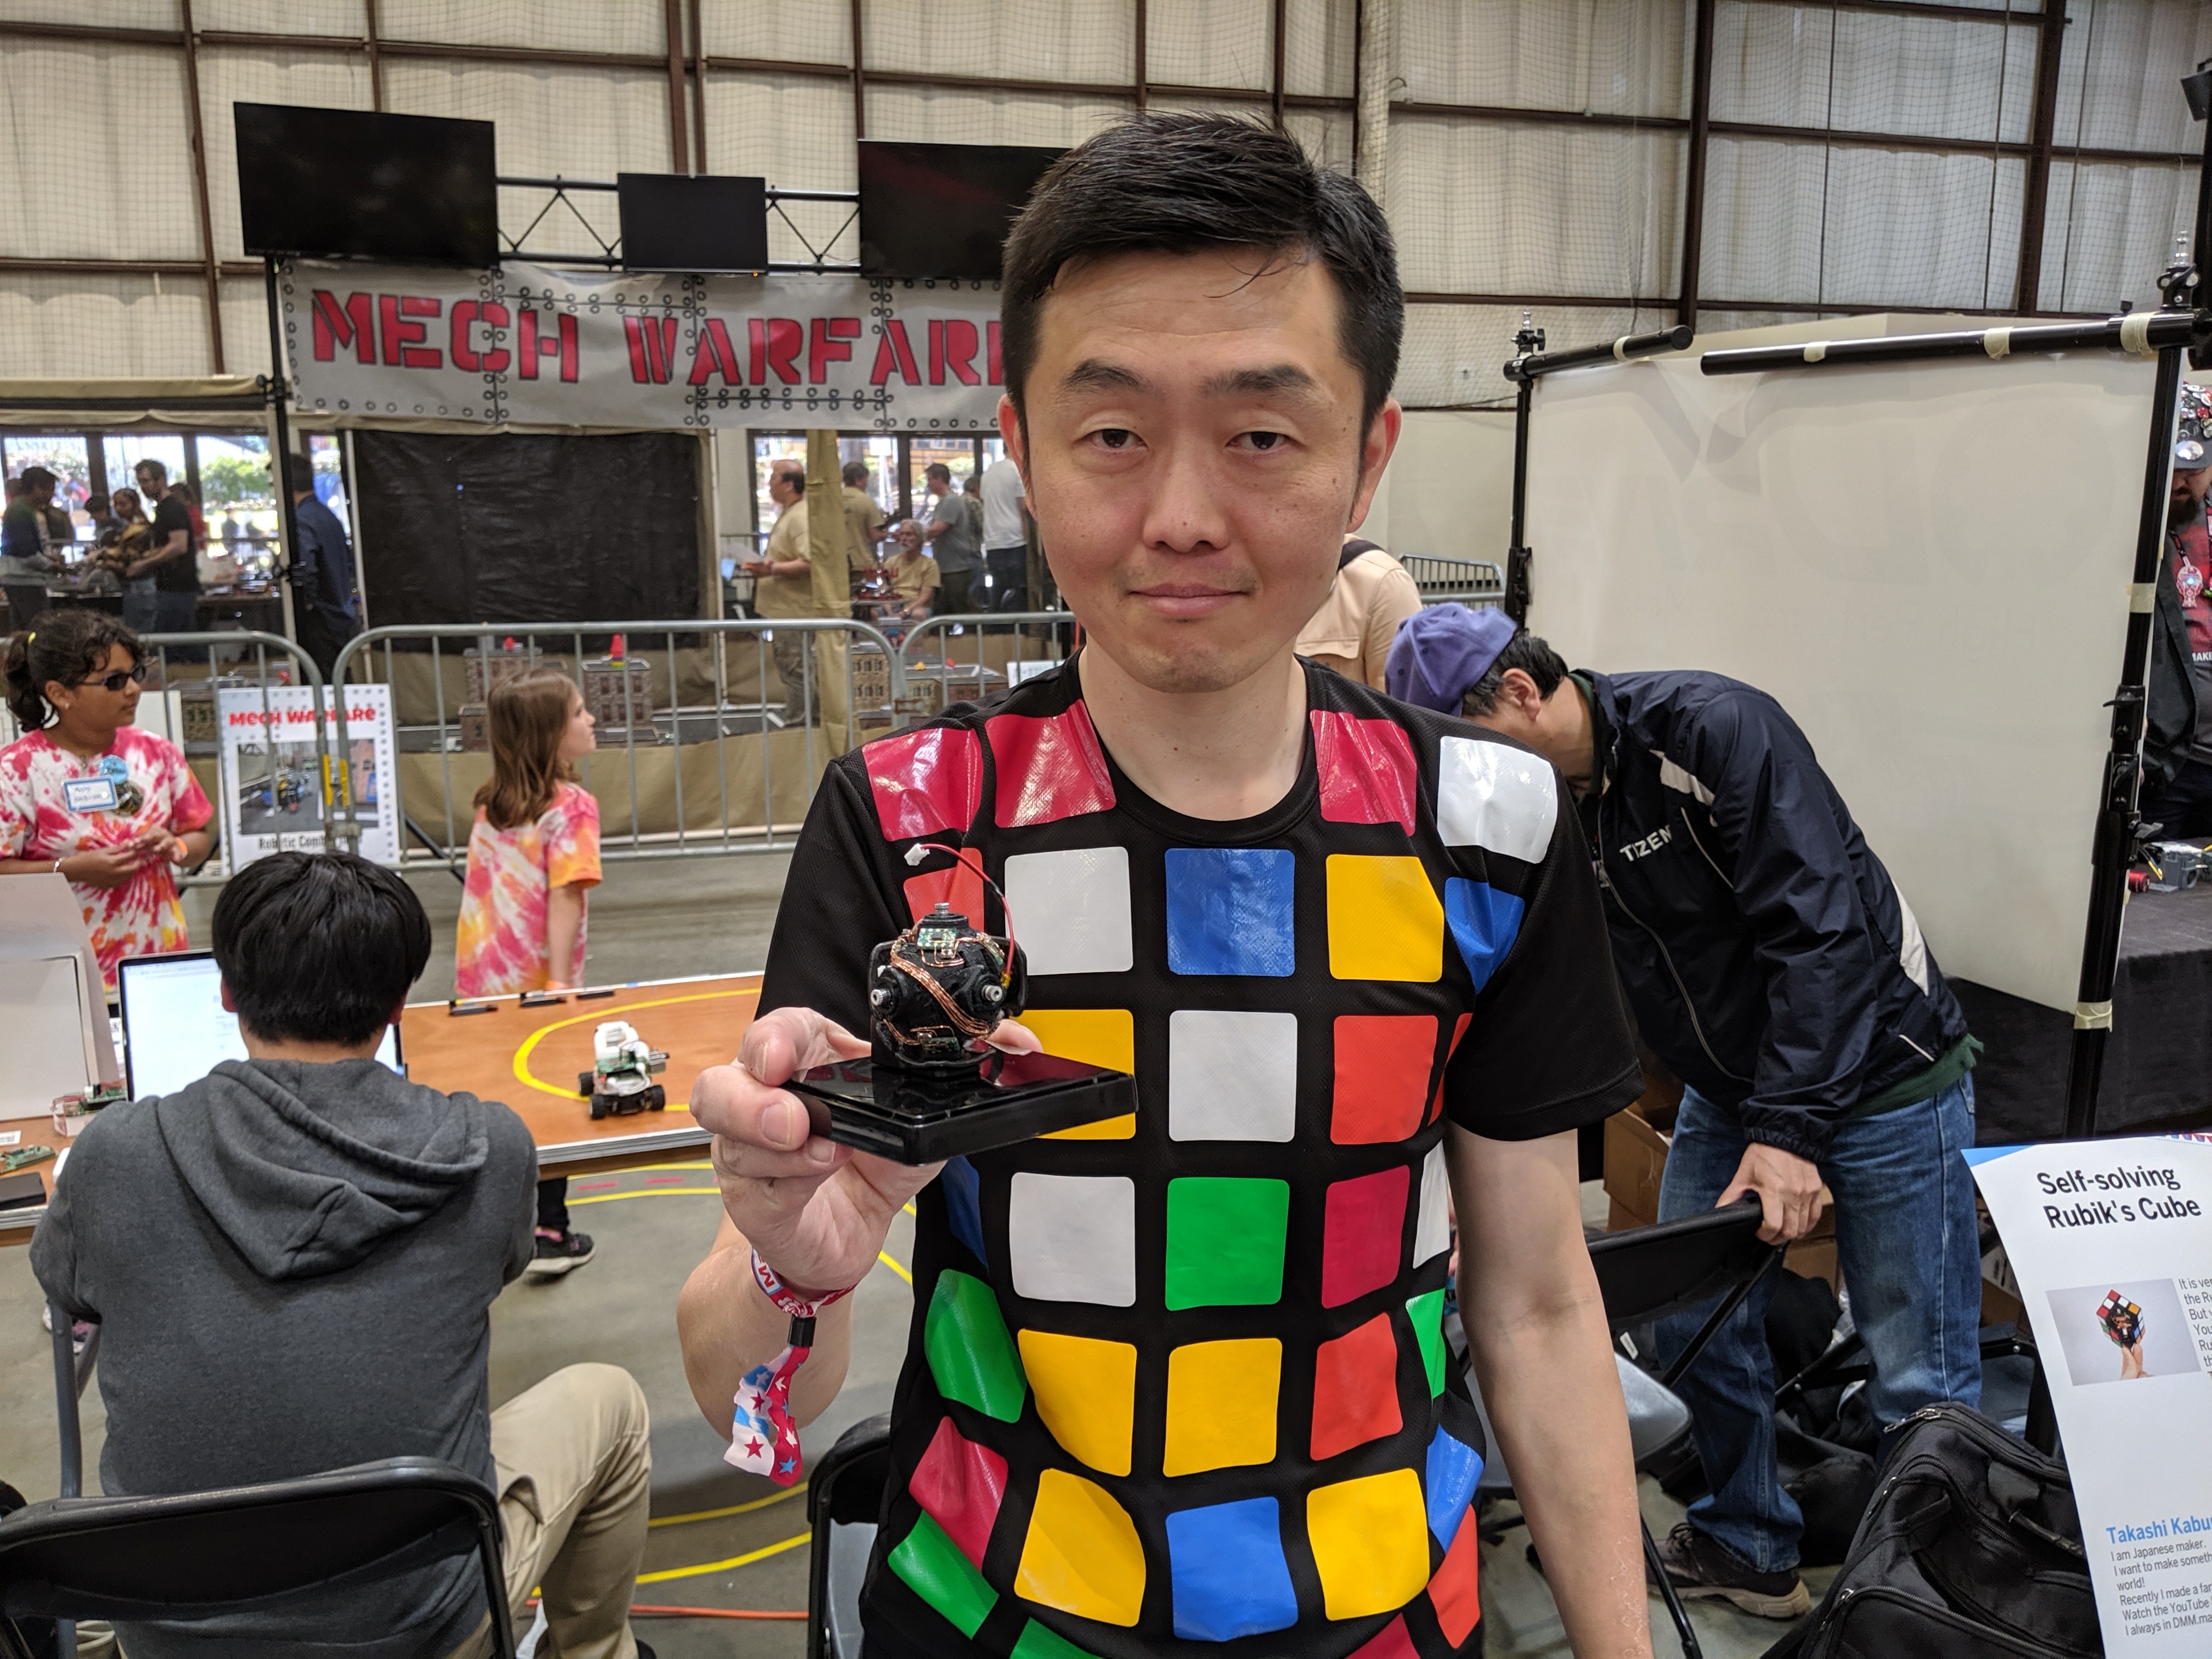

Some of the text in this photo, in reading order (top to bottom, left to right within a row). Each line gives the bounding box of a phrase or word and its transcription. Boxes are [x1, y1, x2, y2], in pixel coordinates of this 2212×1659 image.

[312, 289, 579, 383] MECH
[1620, 824, 1672, 862] TIZEN
[2037, 1165, 2181, 1194] Self-solving
[2042, 1195, 2202, 1228] Rubik's Cube
[2178, 1278, 2188, 1289] It
[2187, 1278, 2197, 1289] is
[2184, 1293, 2200, 1305] the
[2188, 1308, 2208, 1320] But
[2106, 1519, 2168, 1544] Takashi
[2111, 1539, 2207, 1561] I am Japanese maker.
[2114, 1565, 2118, 1576] I
[2119, 1562, 2141, 1576] want
[2142, 1562, 2152, 1572] to
[2154, 1558, 2179, 1570] make
[2117, 1577, 2145, 1591] world!
[2120, 1590, 2158, 1606] Recently
[2160, 1589, 2164, 1600] I
[2166, 1585, 2191, 1599] made
[2192, 1586, 2198, 1595] a
[2122, 1598, 2209, 1621] Watch the YouTube
[2125, 1625, 2129, 1636] I
[2131, 1622, 2161, 1635] always
[2162, 1620, 2171, 1630] in
